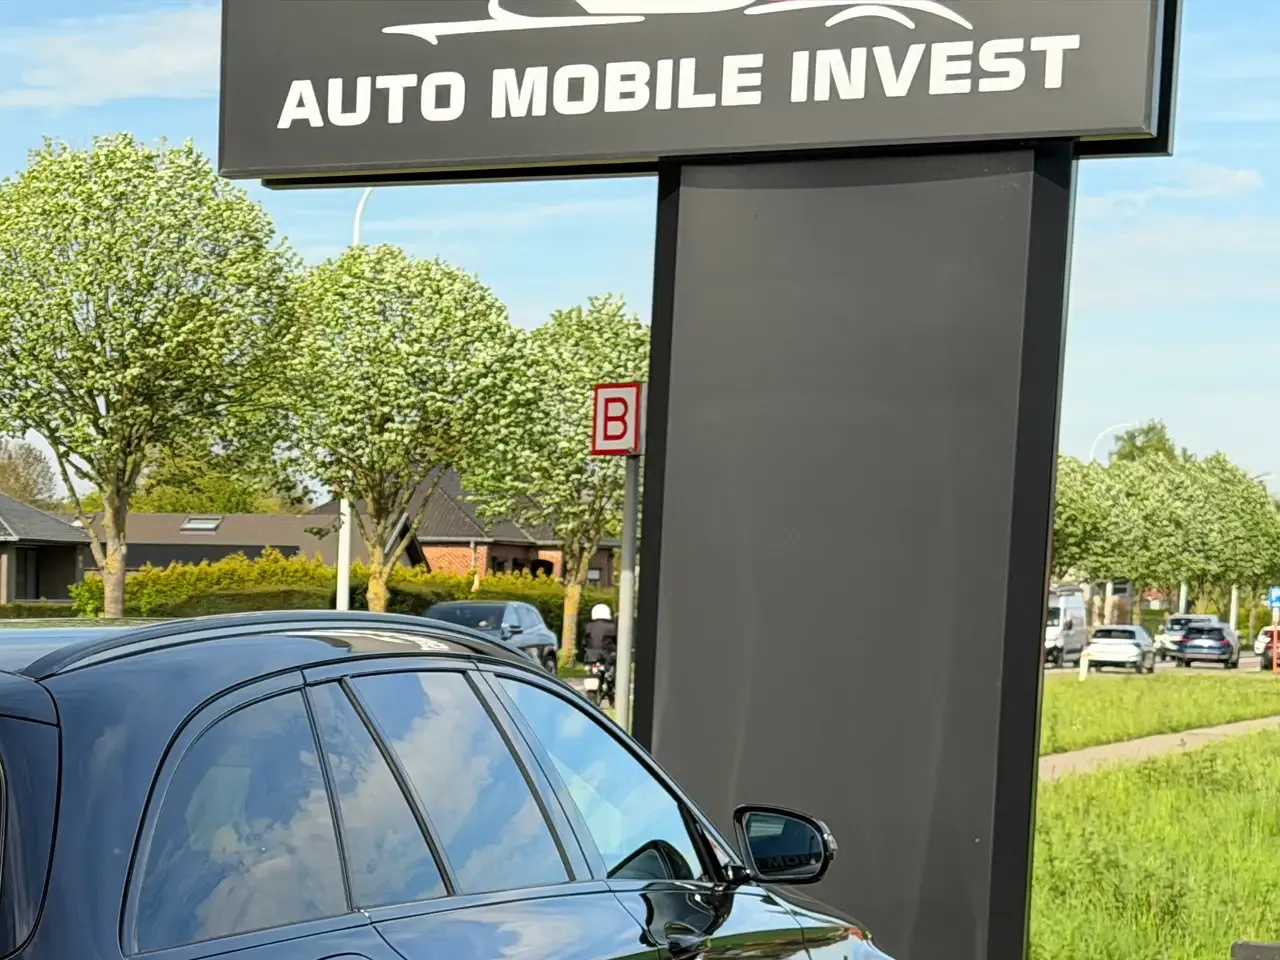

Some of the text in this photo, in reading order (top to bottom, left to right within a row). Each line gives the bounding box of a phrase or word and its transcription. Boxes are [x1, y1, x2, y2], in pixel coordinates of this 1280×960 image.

[276, 34, 1081, 129] AUTO MOBILE INVEST
[603, 397, 629, 441] B
